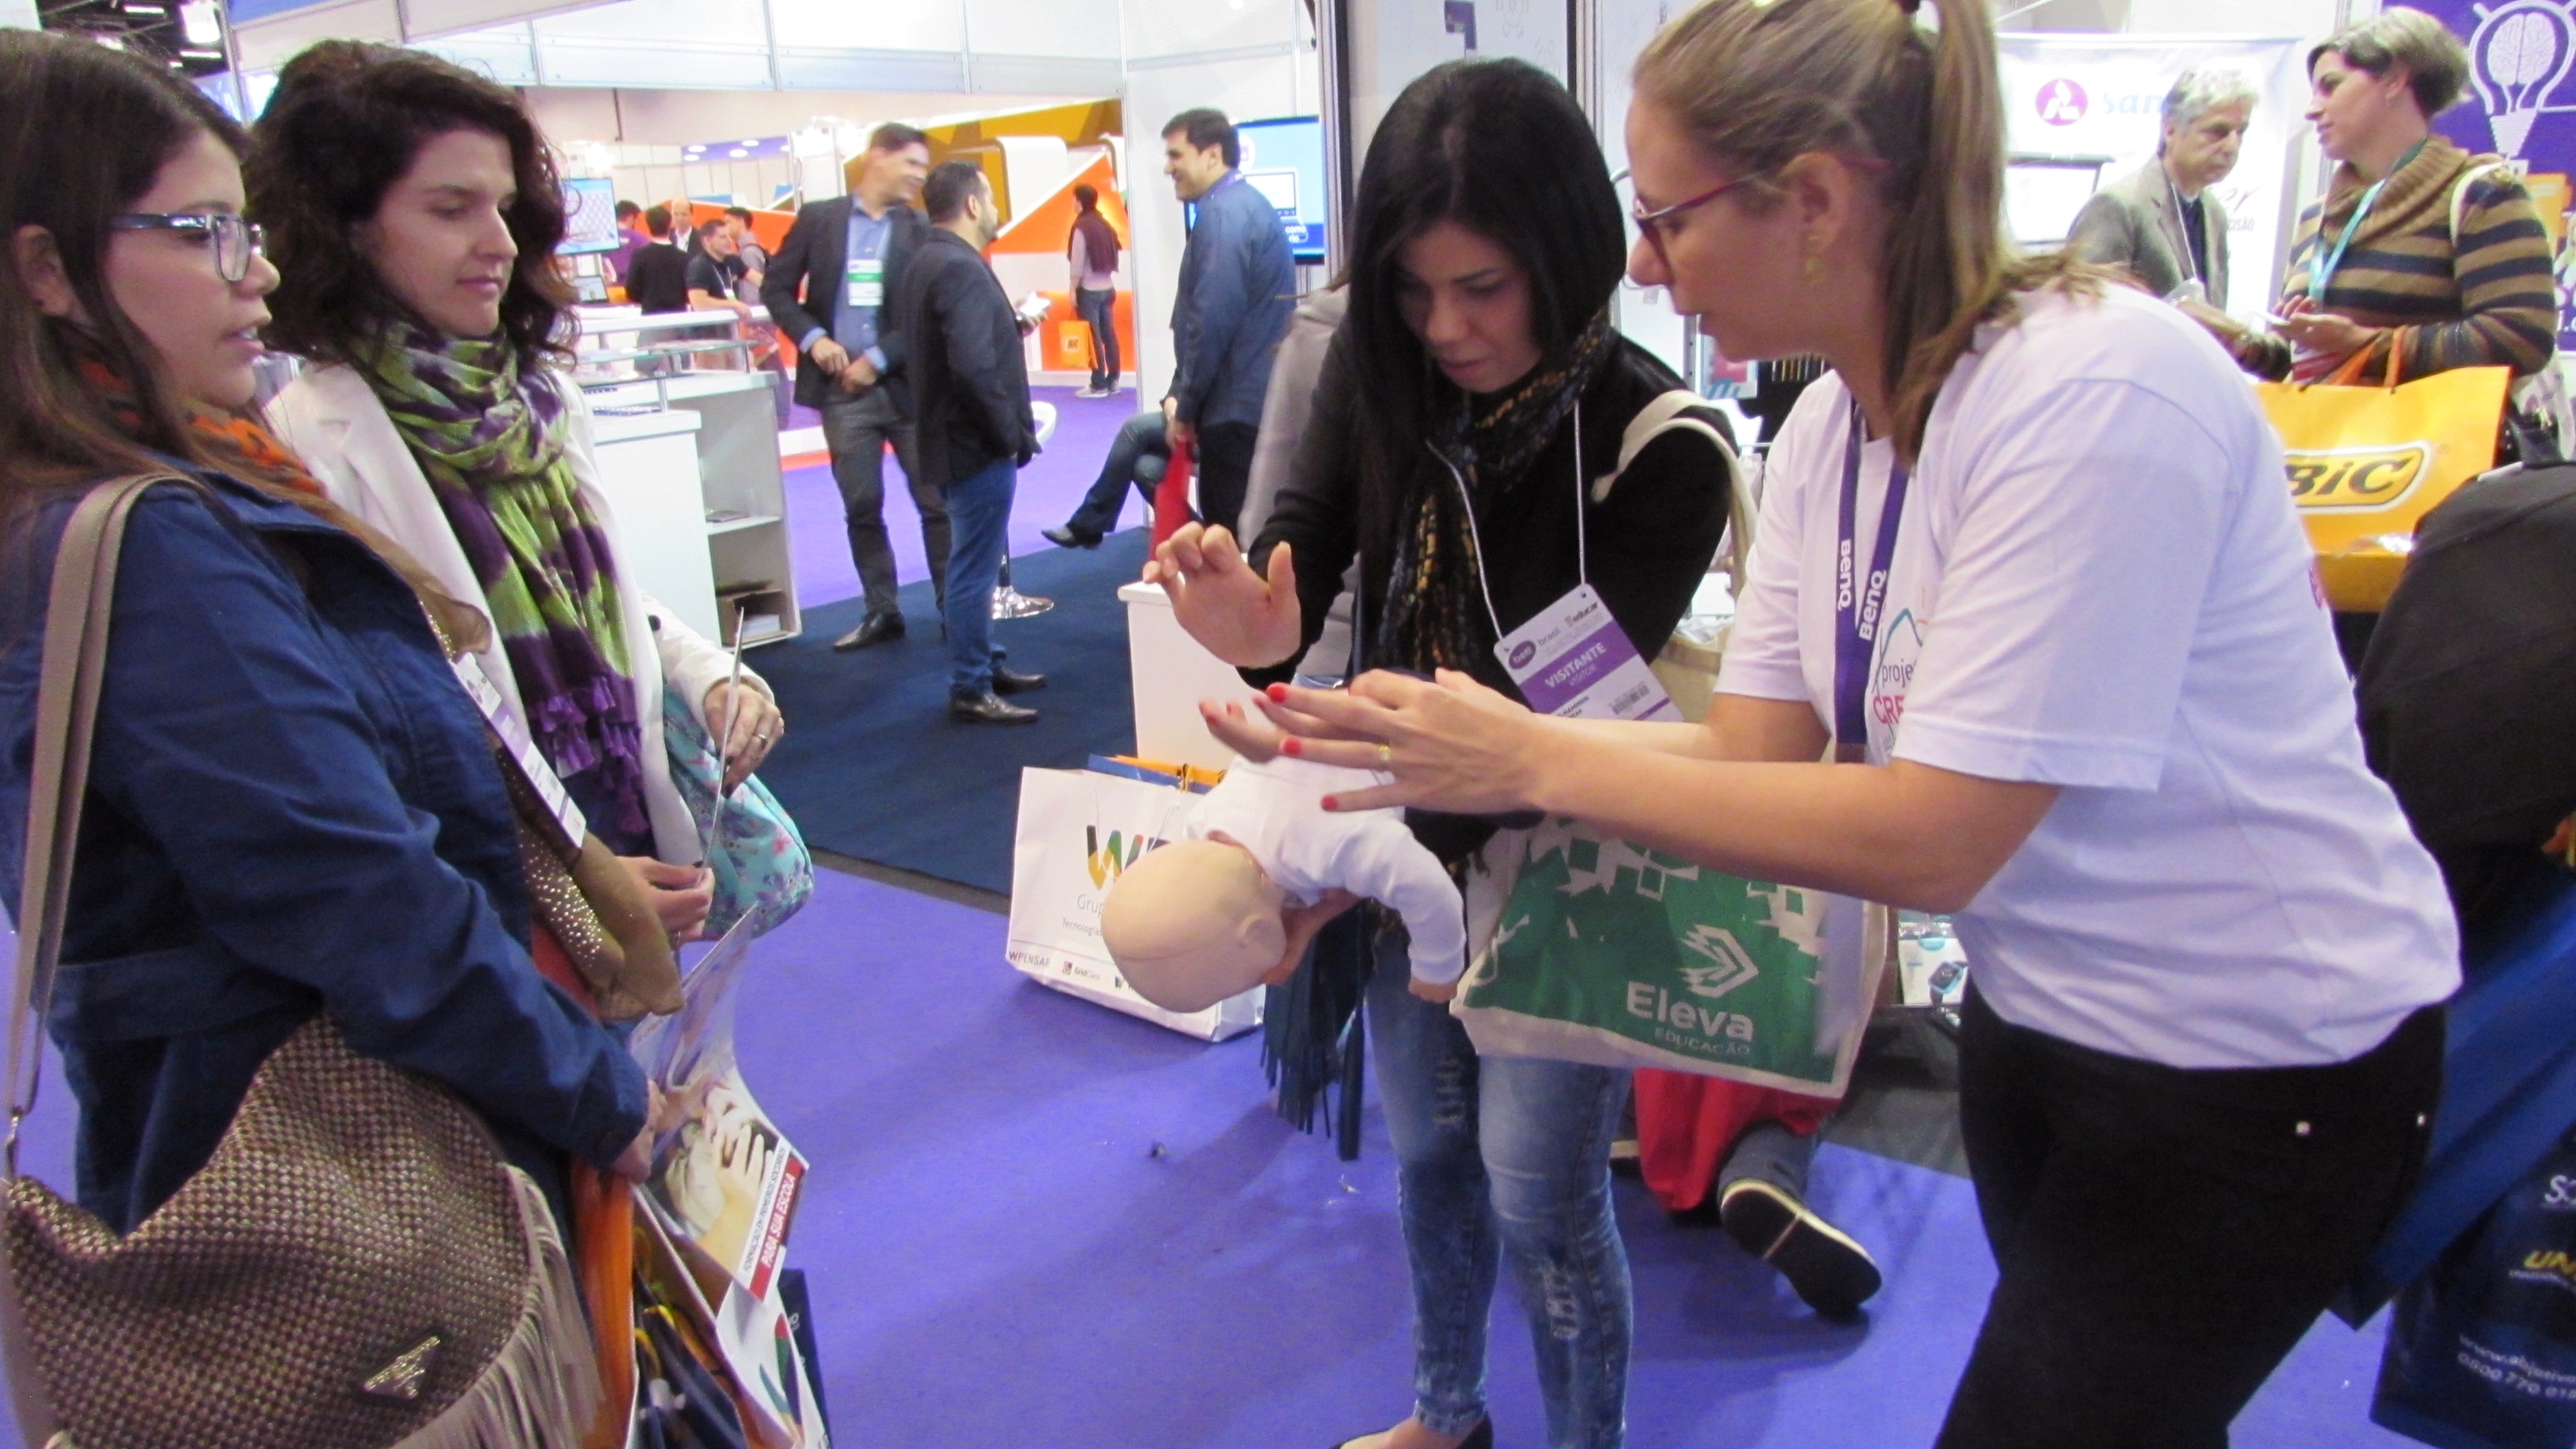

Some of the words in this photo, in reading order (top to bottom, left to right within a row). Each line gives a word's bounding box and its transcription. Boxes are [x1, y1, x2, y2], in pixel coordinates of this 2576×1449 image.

[1837, 538, 1852, 612] BenQ
[1858, 569, 1887, 641] BenQ
[1544, 641, 1606, 689] VISITANTE
[1626, 981, 1754, 1042] Eleva
[776, 1172, 797, 1215] ESCOLA
[769, 1212, 785, 1238] SUA
[760, 1234, 778, 1268] PARA
[2458, 1353, 2503, 1381] 0800
